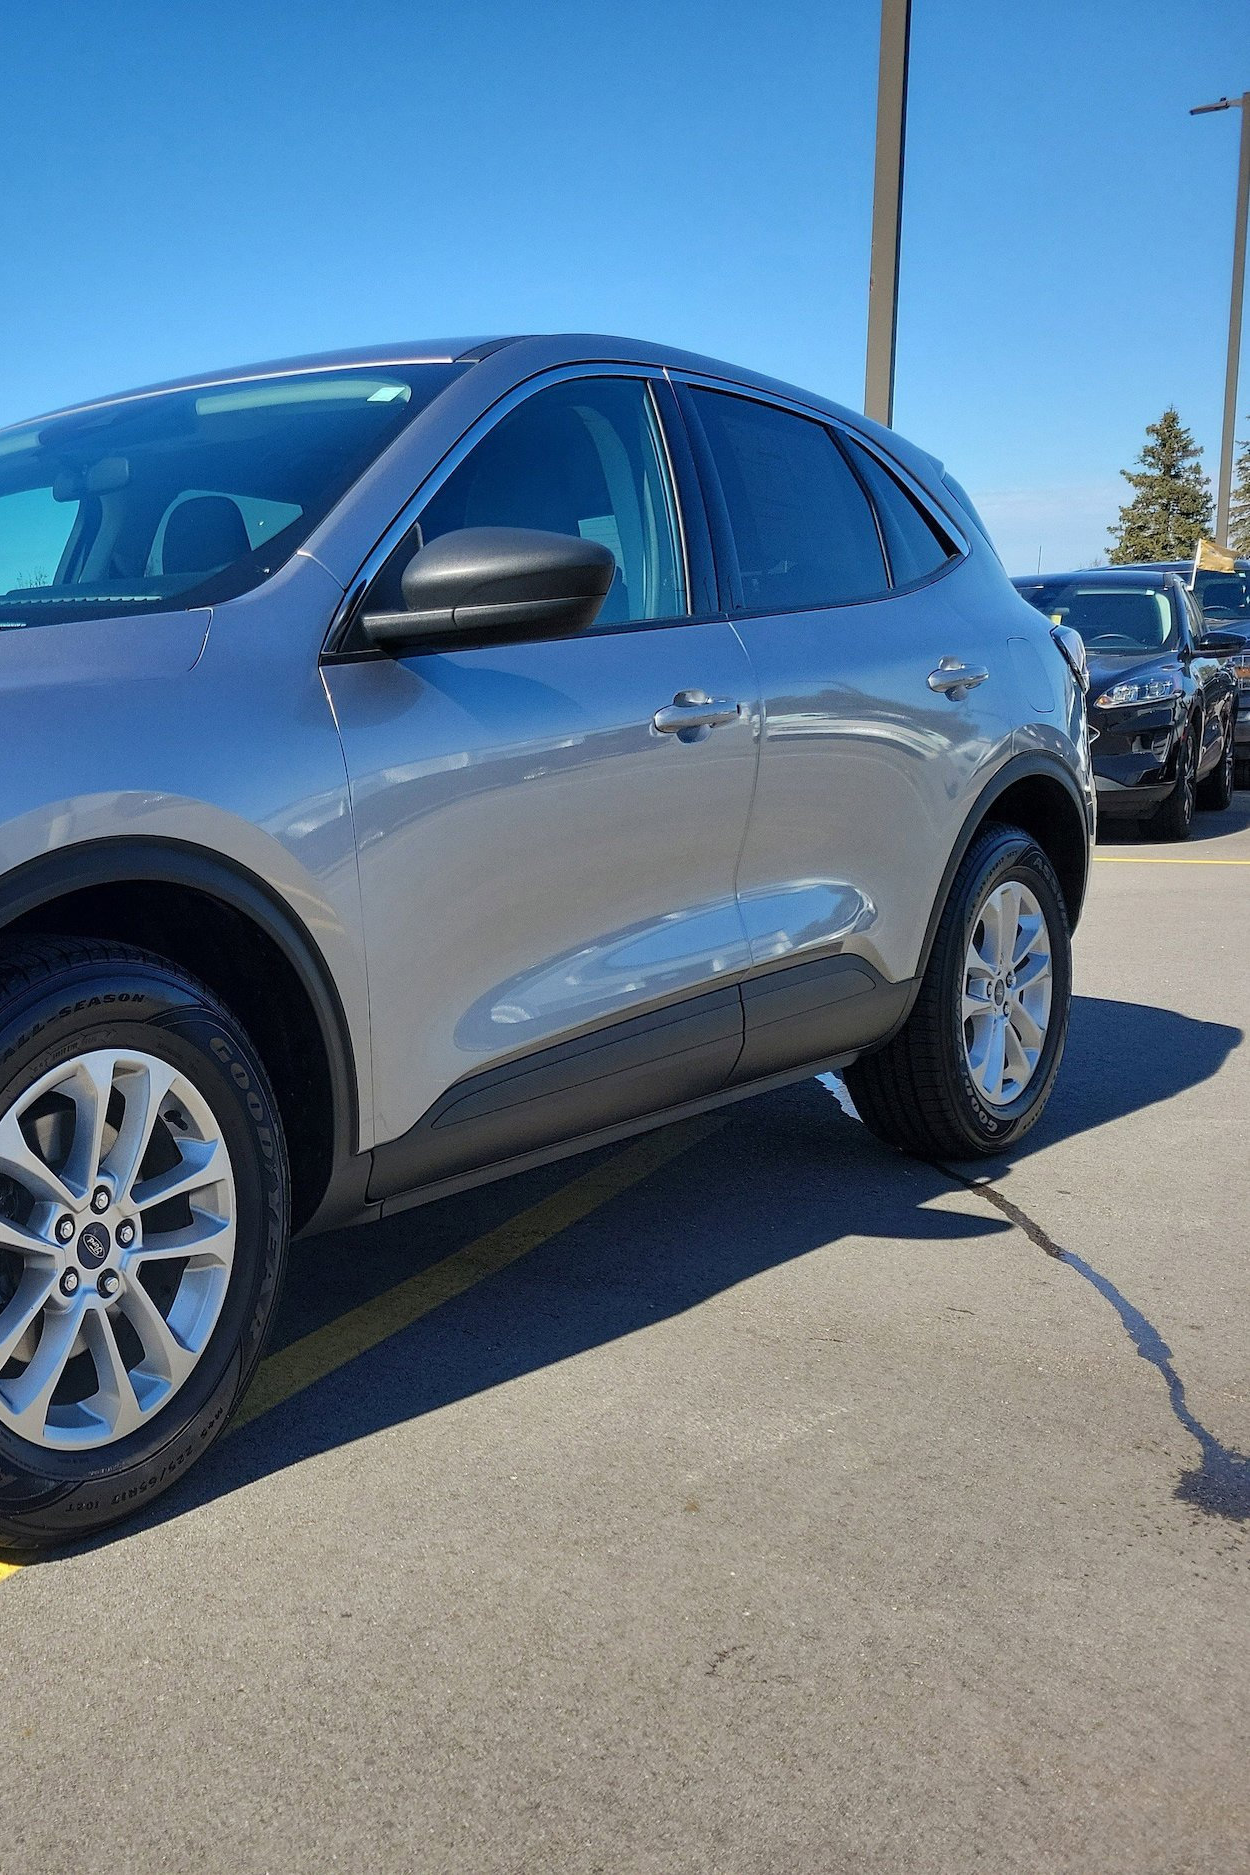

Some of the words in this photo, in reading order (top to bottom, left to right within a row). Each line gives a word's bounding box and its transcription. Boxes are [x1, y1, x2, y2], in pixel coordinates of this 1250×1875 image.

[3, 992, 146, 1063] ALL-SEASON
[209, 1036, 284, 1340] GOODYEAR
[86, 1236, 104, 1256] Ford
